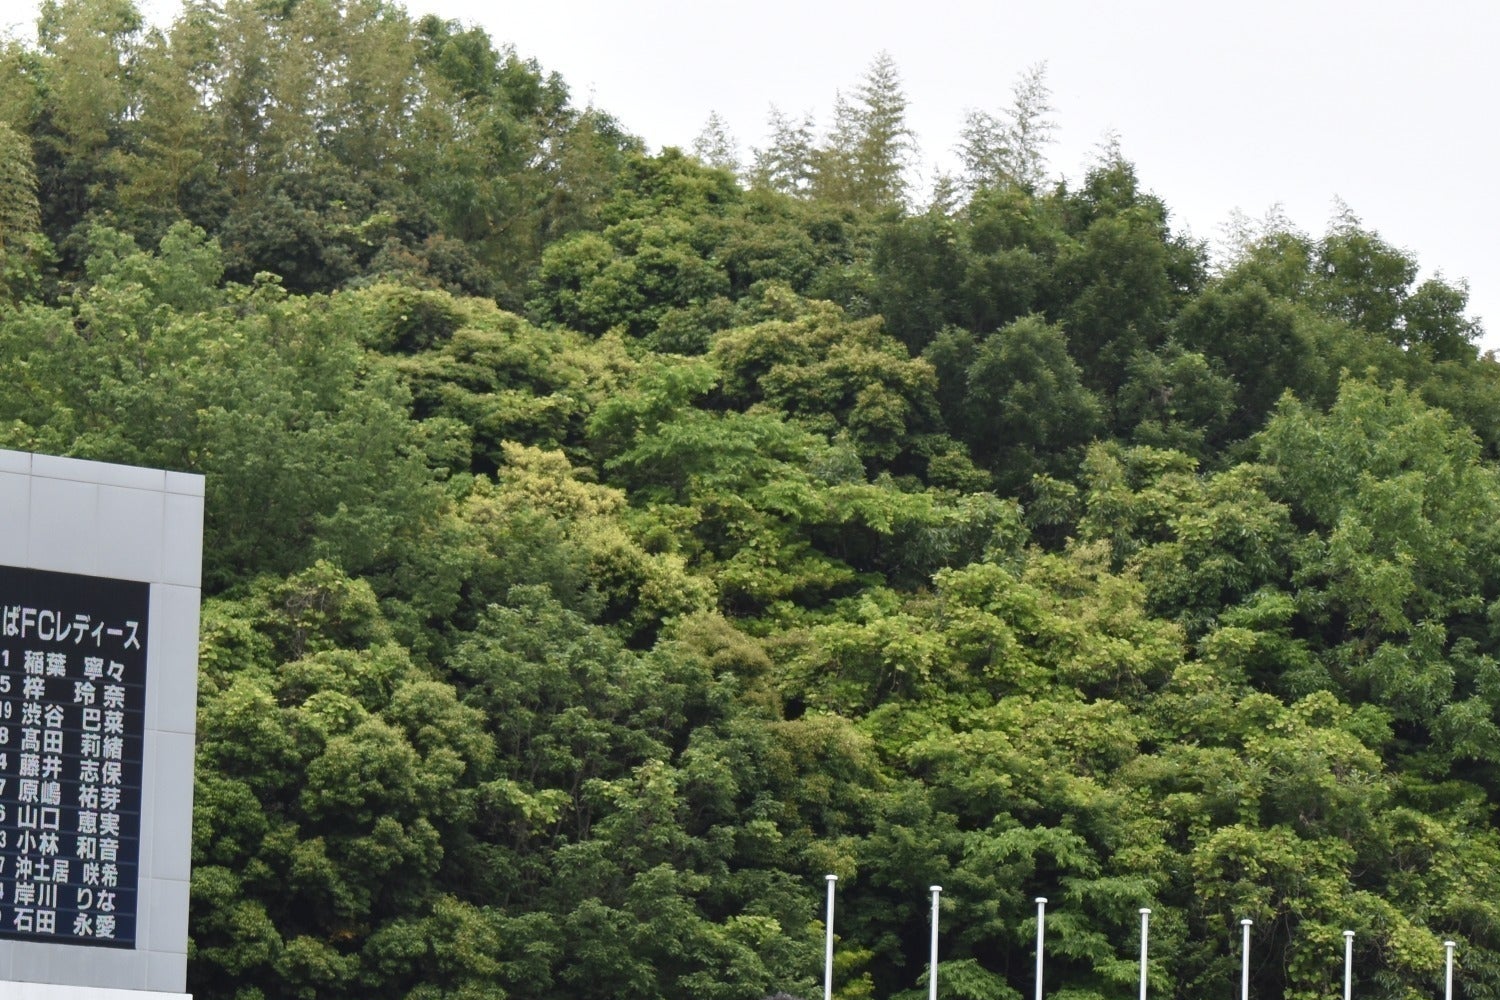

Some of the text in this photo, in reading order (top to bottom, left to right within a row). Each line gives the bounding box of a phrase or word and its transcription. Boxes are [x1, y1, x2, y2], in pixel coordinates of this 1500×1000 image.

[2, 605, 141, 650] ばFCレディース
[24, 650, 66, 677] 稲葉
[84, 656, 125, 682] 寧々
[23, 676, 45, 700] 梓
[74, 681, 125, 709] 玲奈
[21, 702, 64, 728] 渋谷
[83, 708, 124, 734] 巴菜
[81, 733, 124, 760] 莉緒
[20, 753, 62, 780] 藤井
[80, 758, 122, 785] 志保
[18, 779, 61, 806] 原嶋
[78, 784, 121, 810] 祐芽
[17, 804, 60, 831] 山口
[77, 810, 120, 837] 恵実
[16, 830, 59, 856] 小林
[76, 836, 119, 862] 和音
[15, 856, 69, 884] 沖土居
[83, 863, 118, 887] 咲希
[14, 882, 57, 908] 岸川
[77, 888, 115, 912] りな
[14, 907, 56, 934] 石田
[73, 913, 115, 939] 永愛
